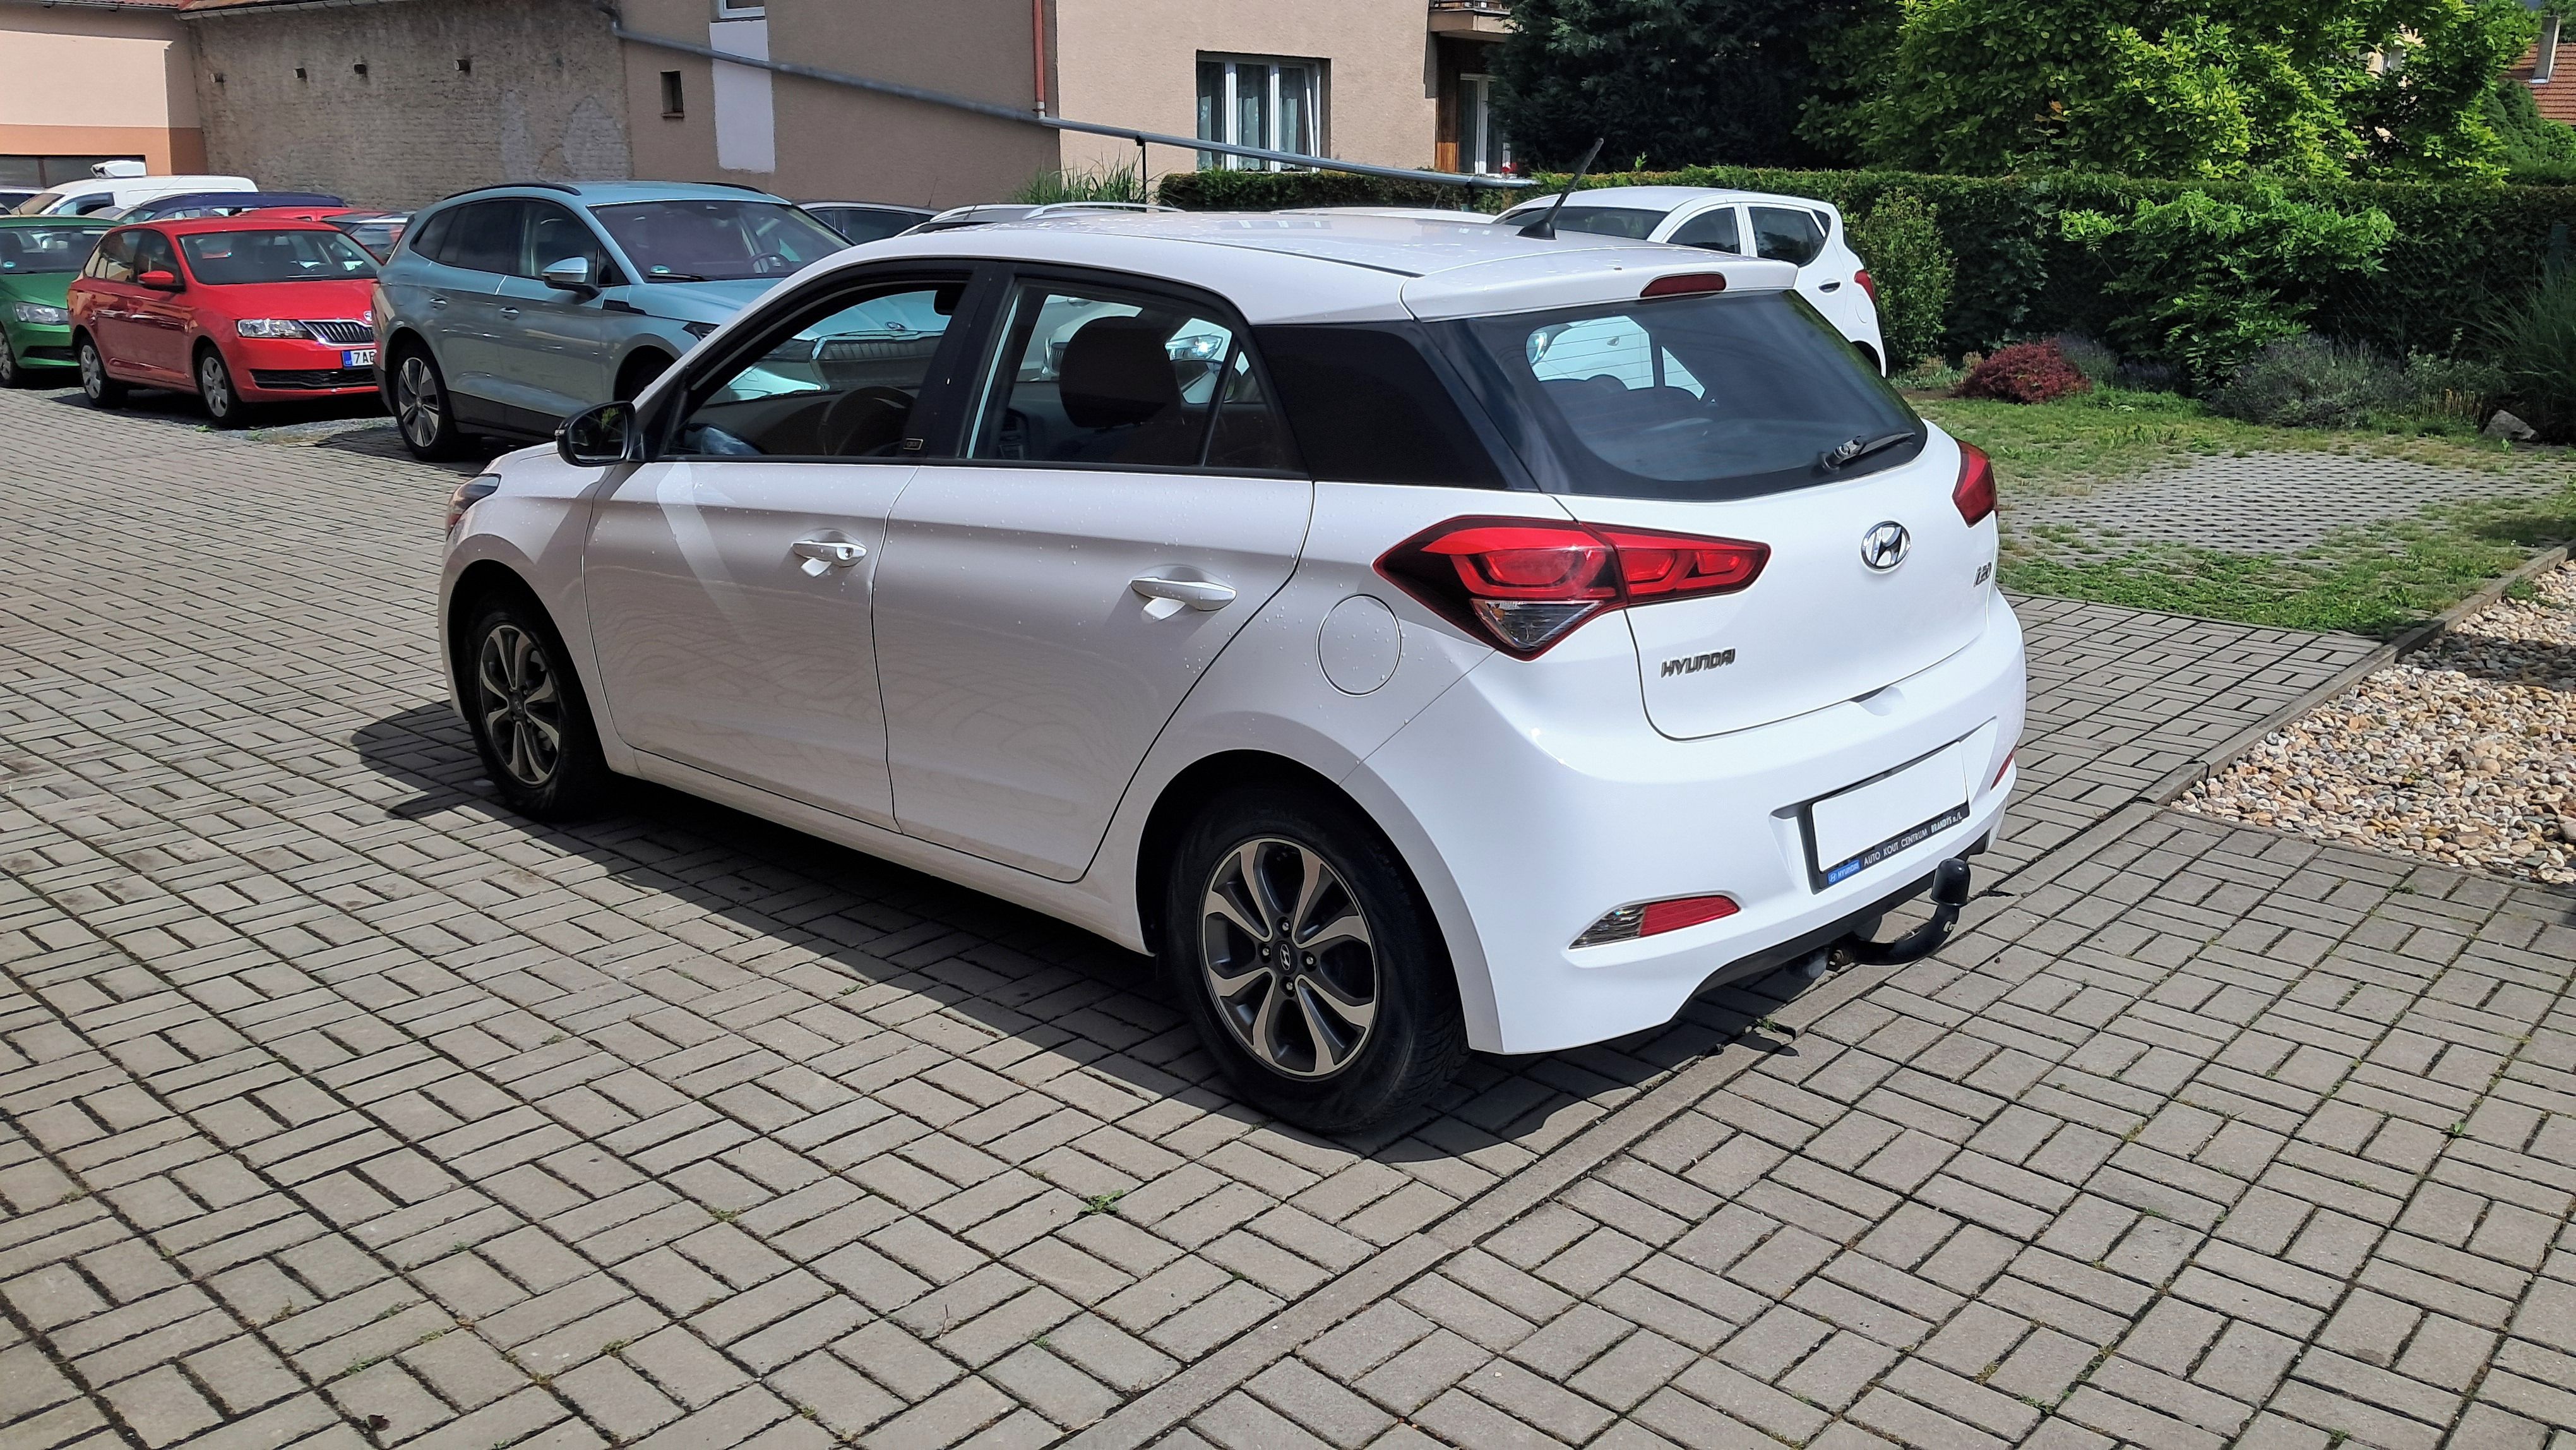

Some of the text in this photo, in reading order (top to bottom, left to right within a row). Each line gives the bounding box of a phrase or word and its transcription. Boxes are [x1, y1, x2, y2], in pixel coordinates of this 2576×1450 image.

[1973, 561, 1992, 588] i20
[1661, 648, 1736, 678] HYUNDAI
[1838, 861, 1859, 878] HYUNDAI
[1863, 851, 1881, 867] AUTO
[1883, 841, 1899, 857] KOUT
[1900, 828, 1928, 848] CENTRUM
